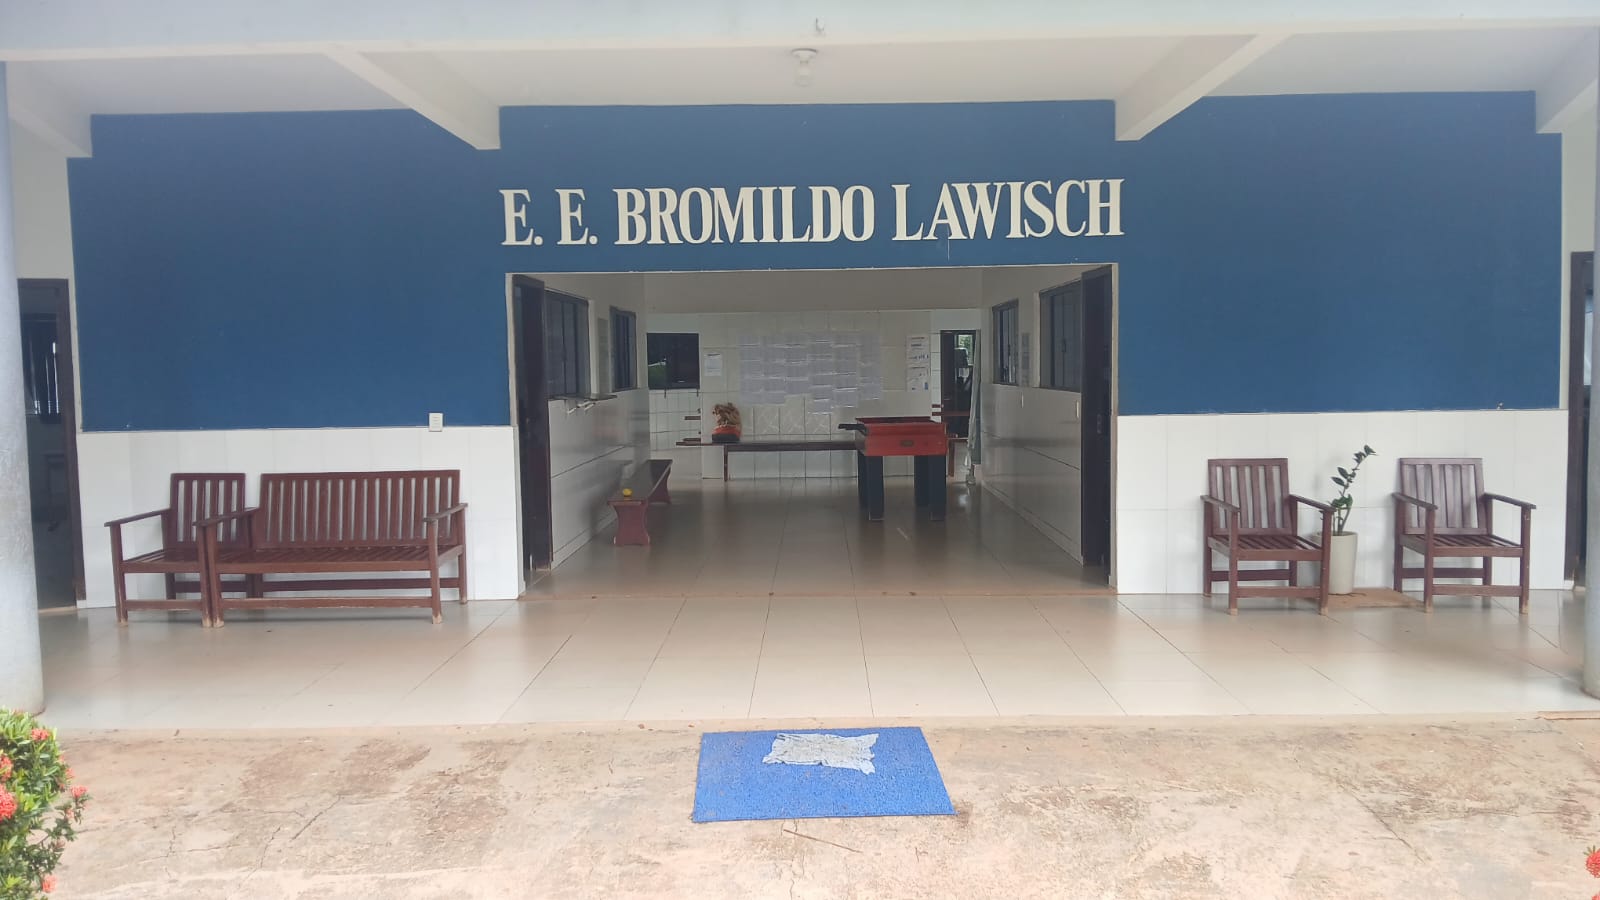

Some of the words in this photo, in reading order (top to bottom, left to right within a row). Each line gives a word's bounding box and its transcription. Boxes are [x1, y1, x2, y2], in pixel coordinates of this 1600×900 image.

[500, 189, 542, 246] E.
[556, 188, 597, 245] E.
[613, 186, 875, 245] BROMILDO
[892, 178, 1125, 241] LAWISCH
